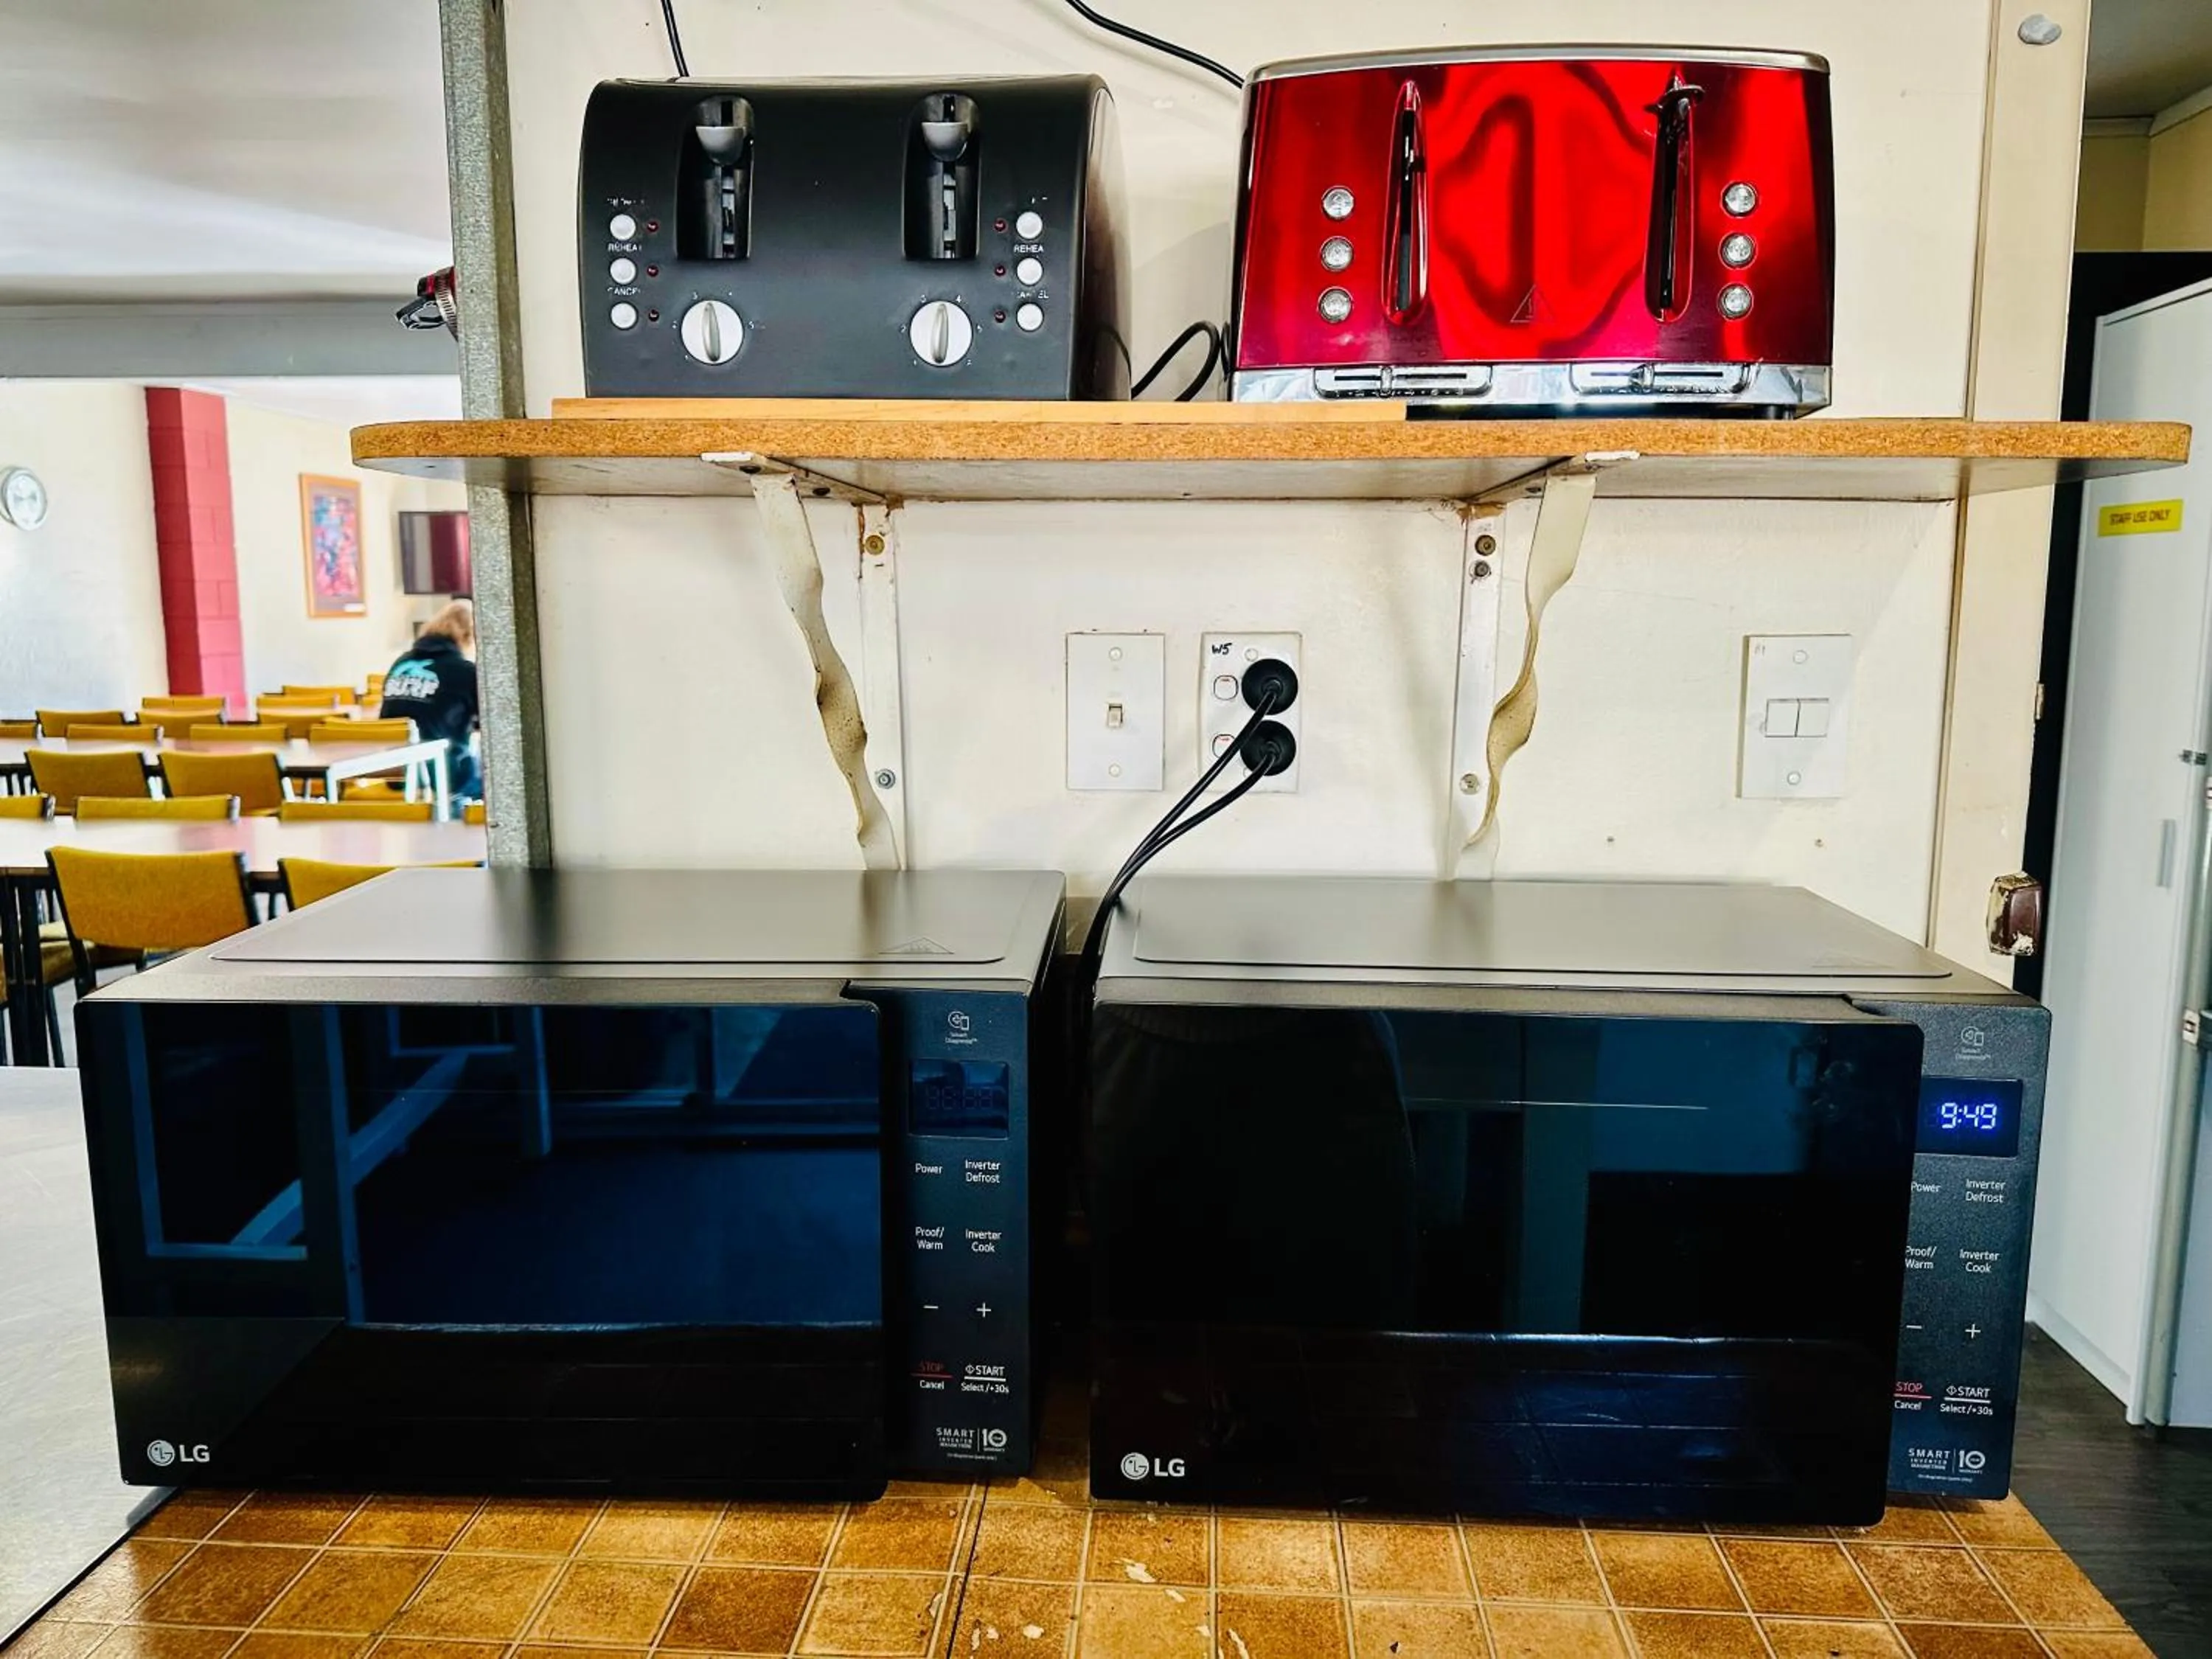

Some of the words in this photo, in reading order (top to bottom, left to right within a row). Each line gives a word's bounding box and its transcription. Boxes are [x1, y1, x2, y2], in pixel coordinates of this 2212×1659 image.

[1941, 1102, 1997, 1130] 9:49
[915, 1163, 943, 1175] Power
[965, 1159, 1001, 1171] Inverter
[965, 1172, 1001, 1183] Defrost
[1910, 1181, 1941, 1193] Power
[1965, 1178, 2006, 1191] Inverter
[1965, 1191, 2003, 1204] Defrost
[915, 1226, 944, 1239] Proof/
[965, 1228, 1002, 1240] Inverter
[917, 1239, 943, 1250] Warm
[971, 1241, 995, 1252] Cook
[1959, 1248, 2000, 1261] Inverter
[1905, 1258, 1934, 1269] Warm
[1965, 1262, 1992, 1273] Cook
[975, 1365, 1005, 1376] START
[919, 1380, 945, 1390] Cancel
[1896, 1381, 1923, 1393] STOP
[1958, 1386, 1991, 1398] START
[1894, 1400, 1922, 1411] Cancel
[936, 1427, 975, 1438] SMART
[179, 1444, 210, 1462] LG
[1908, 1447, 1951, 1459] SMART
[1154, 1458, 1185, 1477] LG
